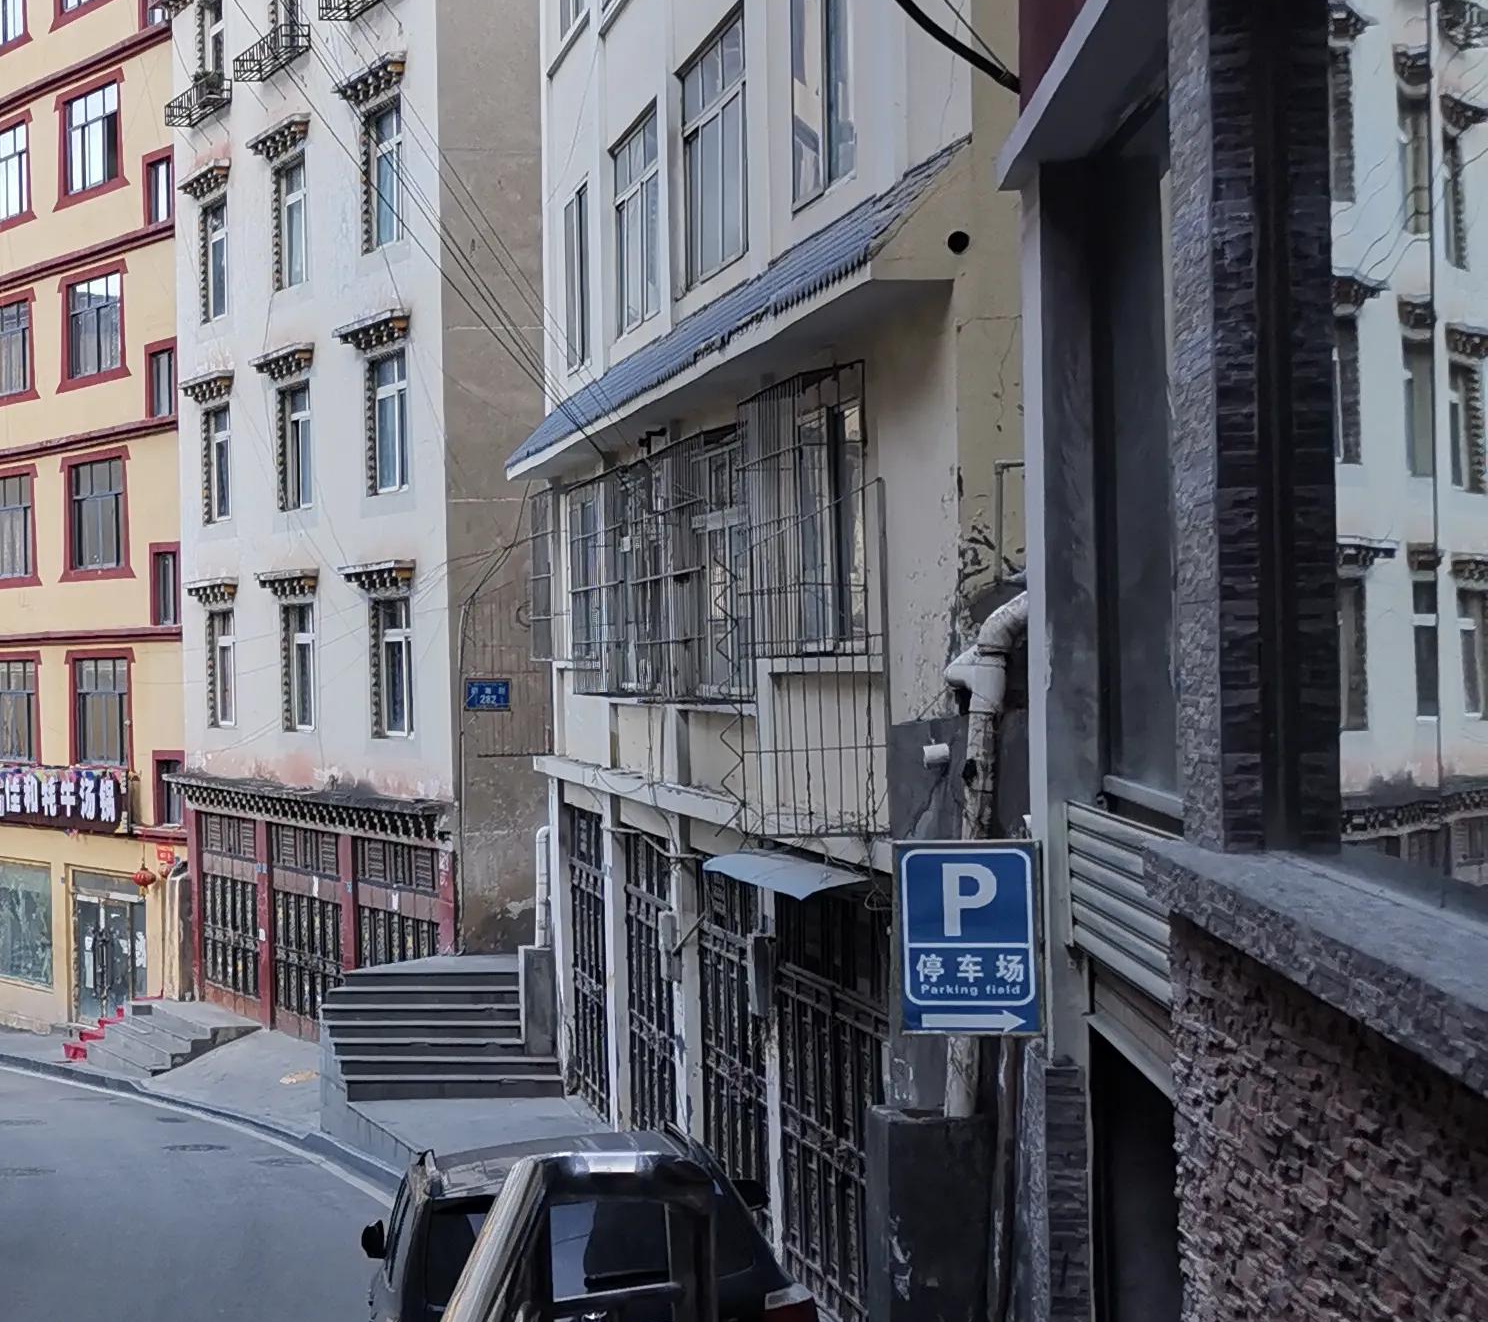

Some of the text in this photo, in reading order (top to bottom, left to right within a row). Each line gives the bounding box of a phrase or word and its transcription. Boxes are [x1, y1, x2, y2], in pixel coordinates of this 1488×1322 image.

[941, 862, 998, 937] P
[915, 953, 1025, 983] 停车场
[920, 984, 1022, 996] Parking field
